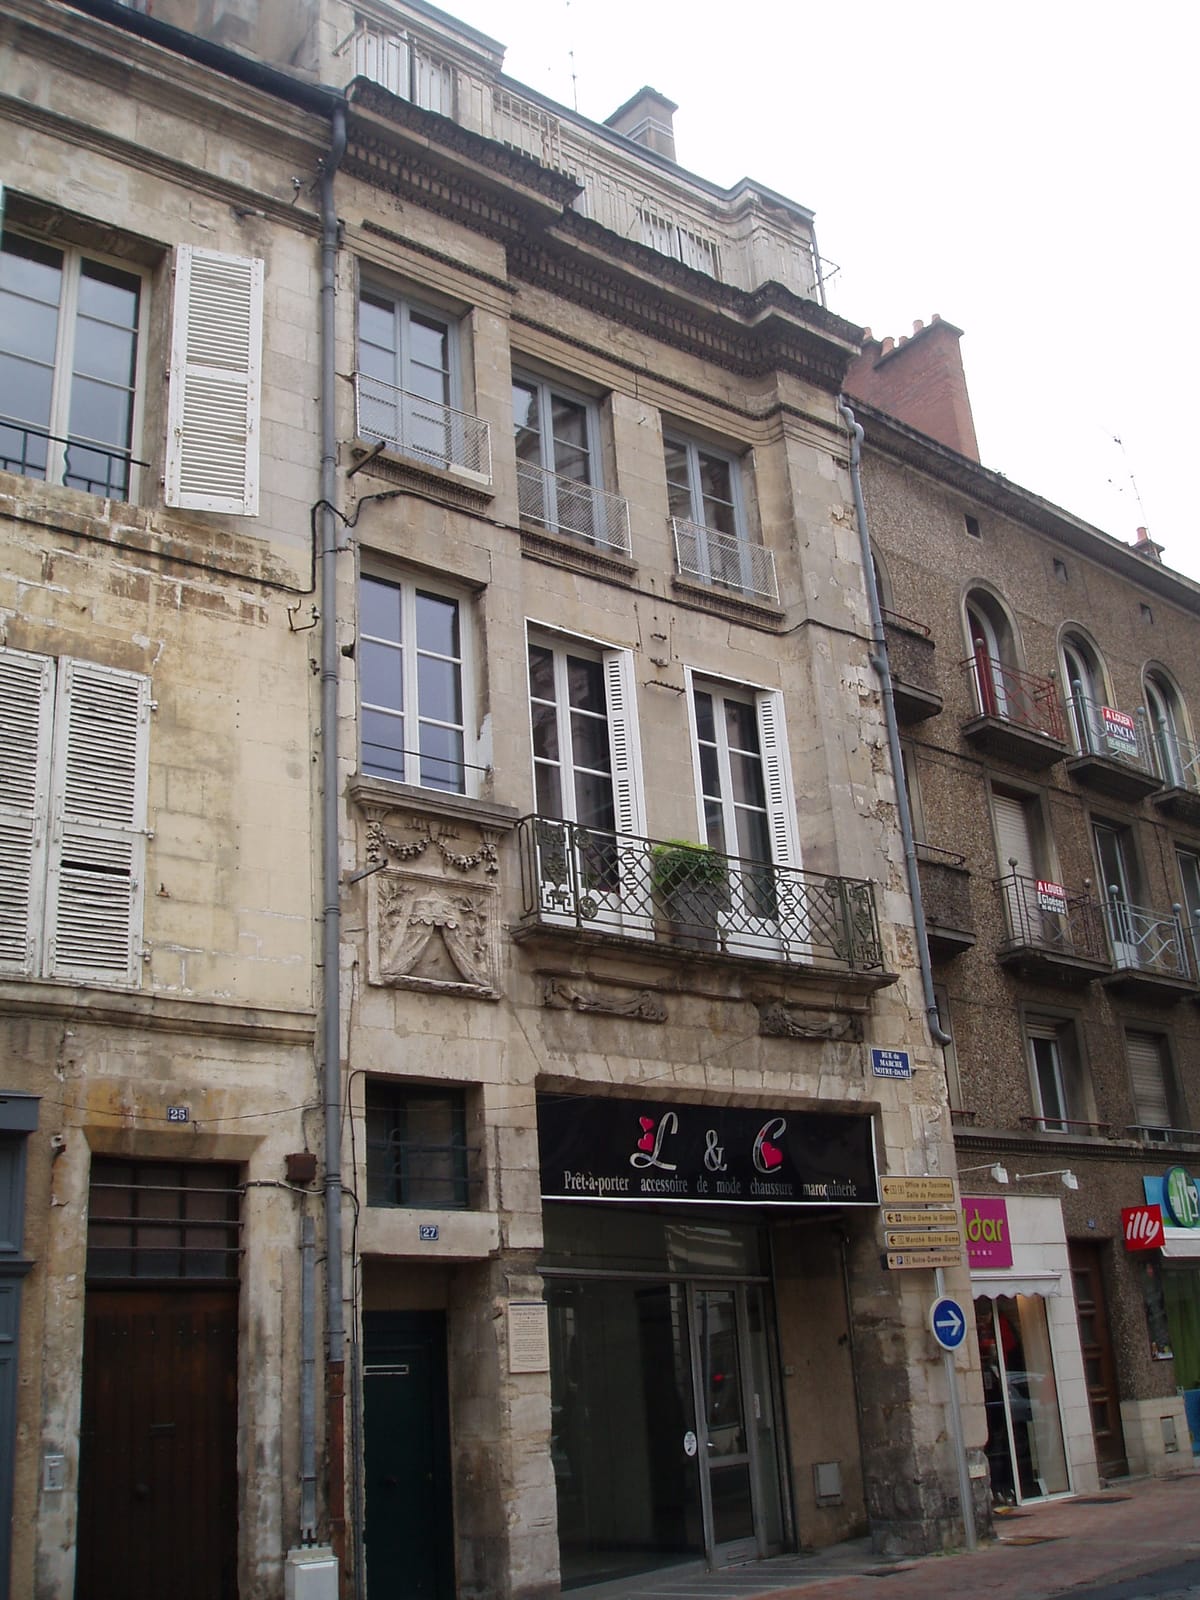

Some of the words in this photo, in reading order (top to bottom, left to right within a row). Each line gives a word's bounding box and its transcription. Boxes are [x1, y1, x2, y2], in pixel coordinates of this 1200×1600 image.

[1105, 720, 1135, 740] FONCIA
[170, 1109, 186, 1120] 25
[629, 1111, 679, 1172] L
[704, 1129, 728, 1172] &
[640, 1174, 688, 1193] accessoire
[696, 1175, 708, 1193] de
[716, 1175, 741, 1194] mode
[750, 1177, 793, 1195] chaussure
[803, 1179, 857, 1200] maroquinerie
[423, 1226, 436, 1237] 27
[1126, 1211, 1160, 1245] illy
